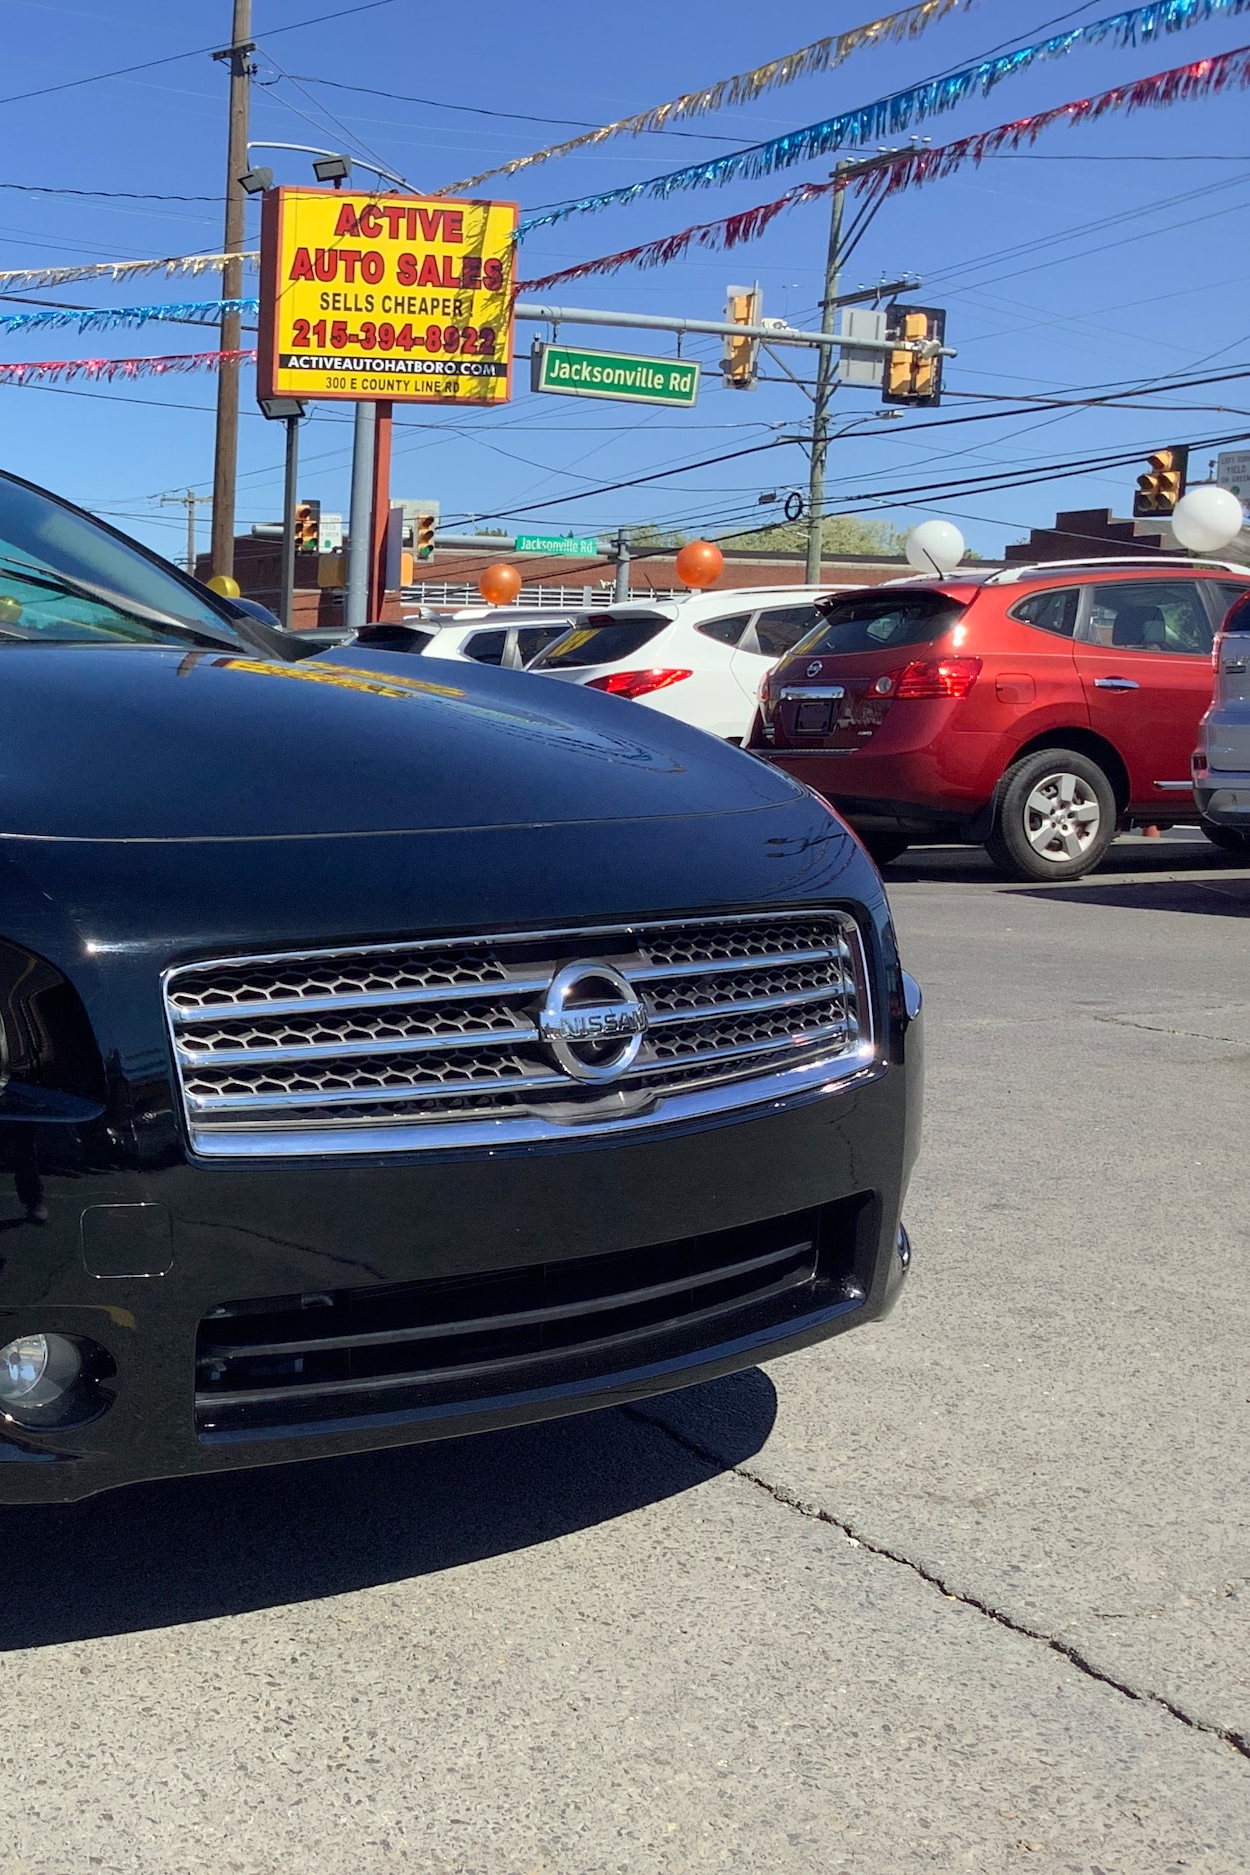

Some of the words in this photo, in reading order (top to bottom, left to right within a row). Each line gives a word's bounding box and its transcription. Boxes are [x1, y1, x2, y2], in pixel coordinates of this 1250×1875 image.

[334, 203, 463, 243] ACTIVE
[289, 247, 384, 285] AUTO
[396, 253, 504, 291] SALES
[319, 292, 375, 313] SELLS
[291, 319, 496, 355] 215-394-8922
[288, 356, 496, 376] ACTIVEAUTOHATBORO.COM
[550, 359, 664, 389] Jacksonville
[669, 373, 692, 393] Rd
[326, 377, 346, 390] 300
[351, 378, 357, 390] E
[361, 378, 410, 392] COUNTY
[414, 380, 441, 393] LINE
[445, 382, 460, 393] RD
[1227, 465, 1246, 474] YIELD
[521, 538, 579, 553] Jacksonville
[580, 540, 593, 553] Rd
[561, 1009, 647, 1037] NISSAN
